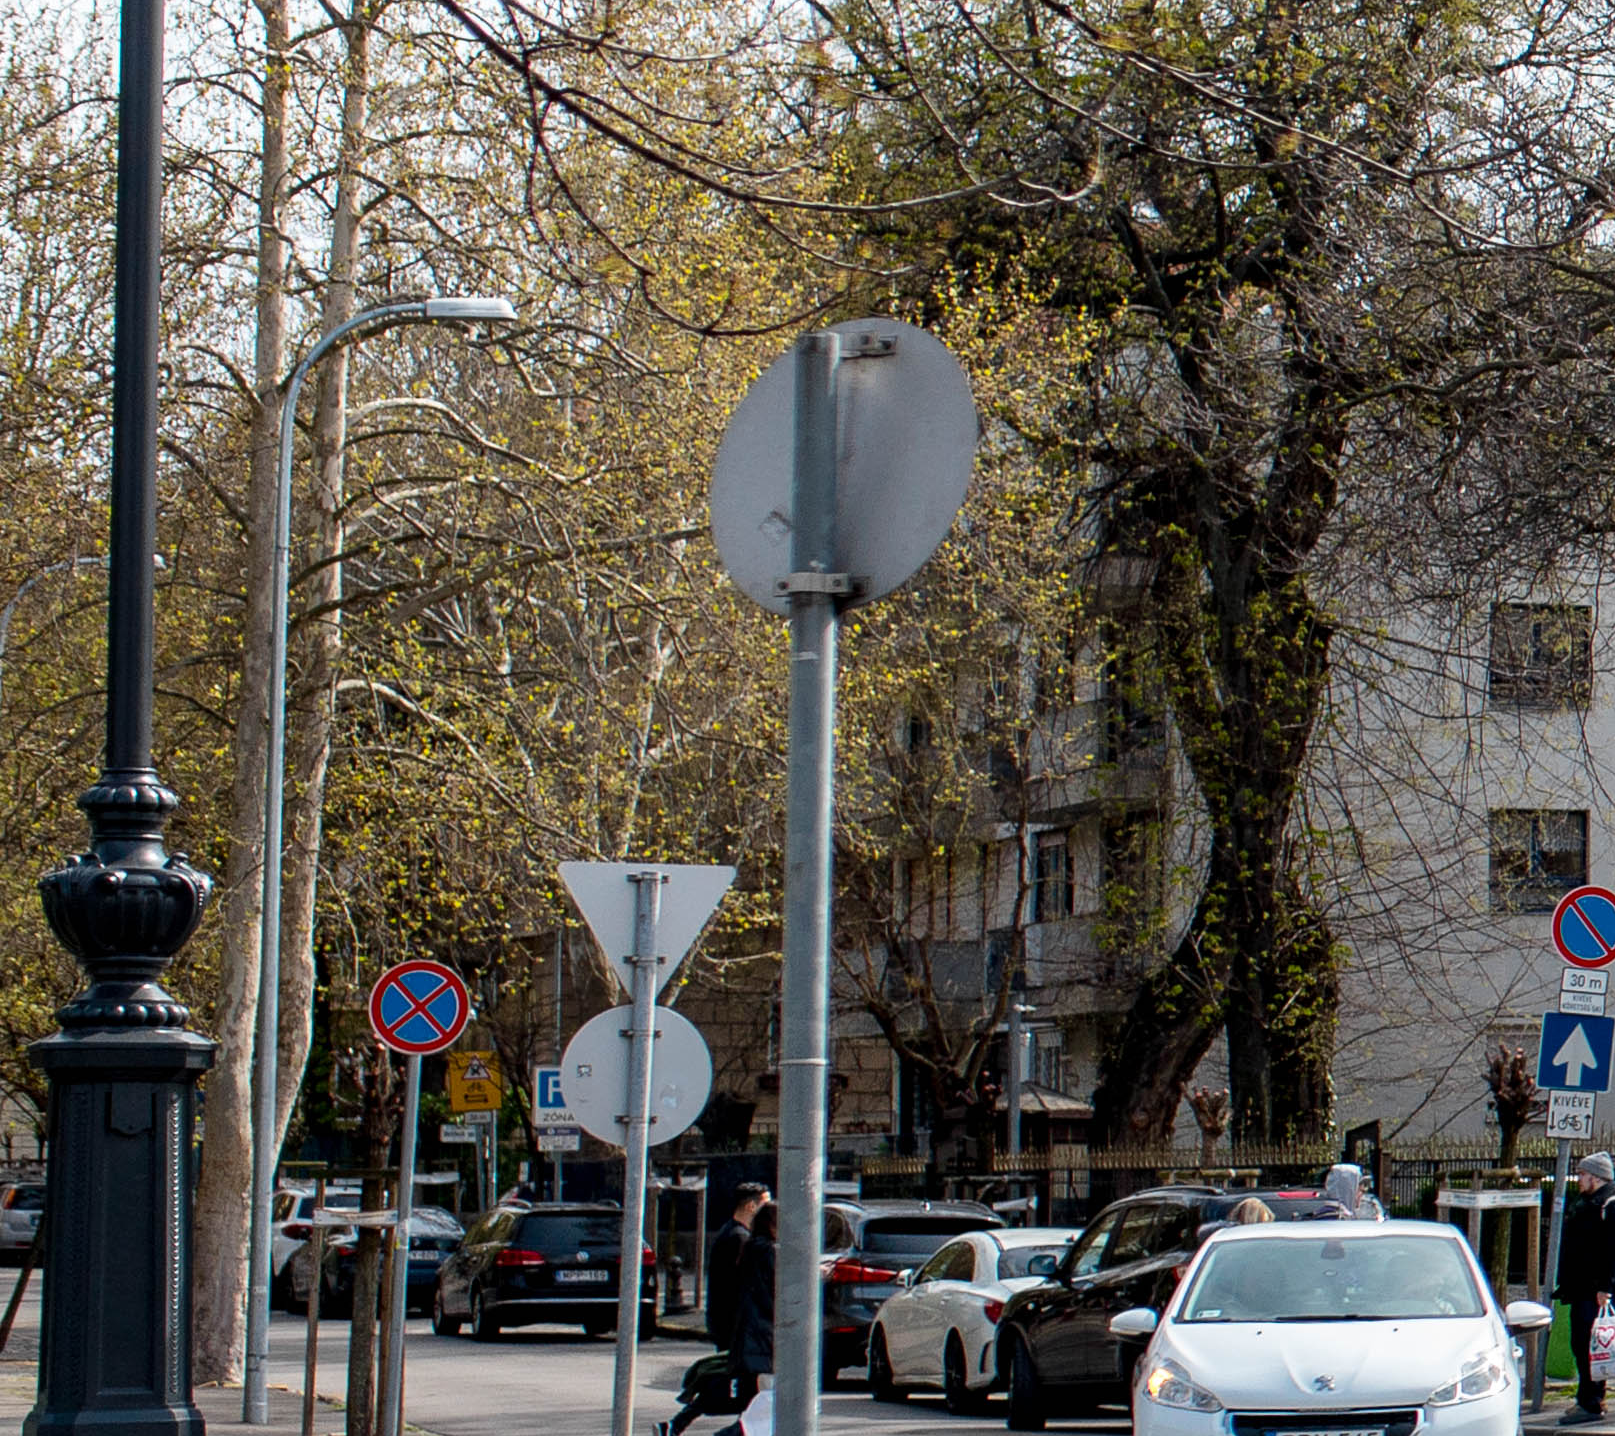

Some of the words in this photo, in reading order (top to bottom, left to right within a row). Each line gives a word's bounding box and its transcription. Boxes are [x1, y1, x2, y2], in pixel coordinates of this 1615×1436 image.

[1570, 973, 1586, 988] 30
[1589, 978, 1602, 989] m
[1553, 1094, 1591, 1109] KIVÉVE
[543, 1111, 575, 1122] ZÓNA
